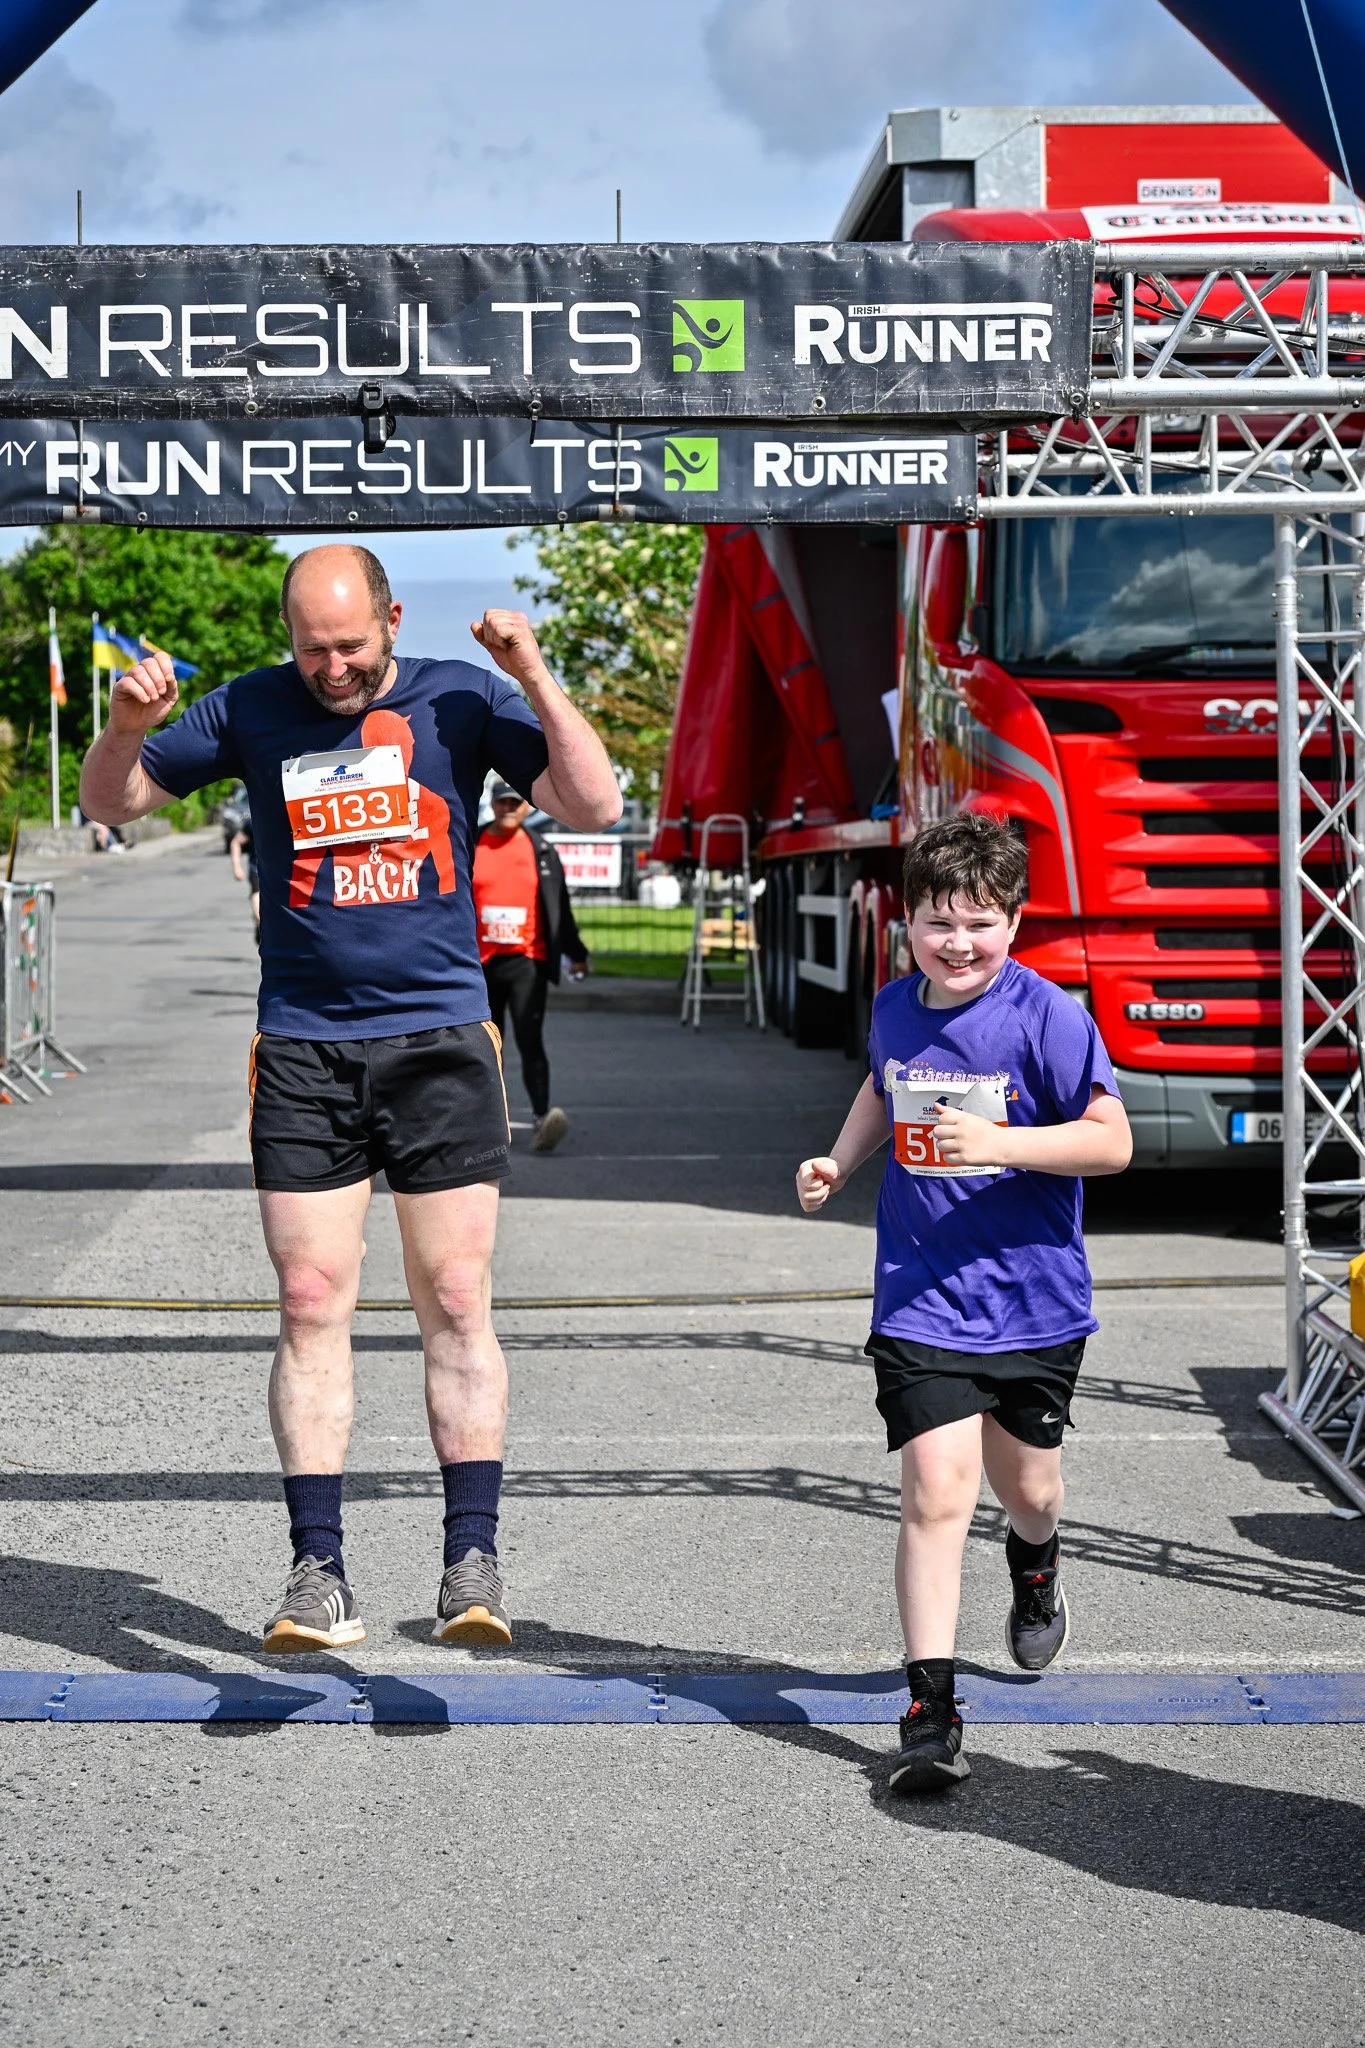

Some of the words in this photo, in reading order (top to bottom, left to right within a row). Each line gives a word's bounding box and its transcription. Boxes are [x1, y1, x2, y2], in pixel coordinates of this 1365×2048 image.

[1141, 186, 1217, 198] DENNISON
[853, 306, 881, 315] IRISH
[100, 301, 641, 377] RESULTS
[794, 304, 1053, 365] RUNNER
[45, 440, 220, 496] RUN
[241, 437, 642, 495] RESULTS
[754, 441, 948, 487] RUNNER
[339, 772, 364, 780] BURREN
[303, 791, 392, 834] 5133
[368, 842, 383, 865] &
[334, 858, 423, 903] BACK
[1128, 1003, 1148, 1020] R
[1150, 1003, 1204, 1020] 580
[906, 1127, 941, 1163] 51
